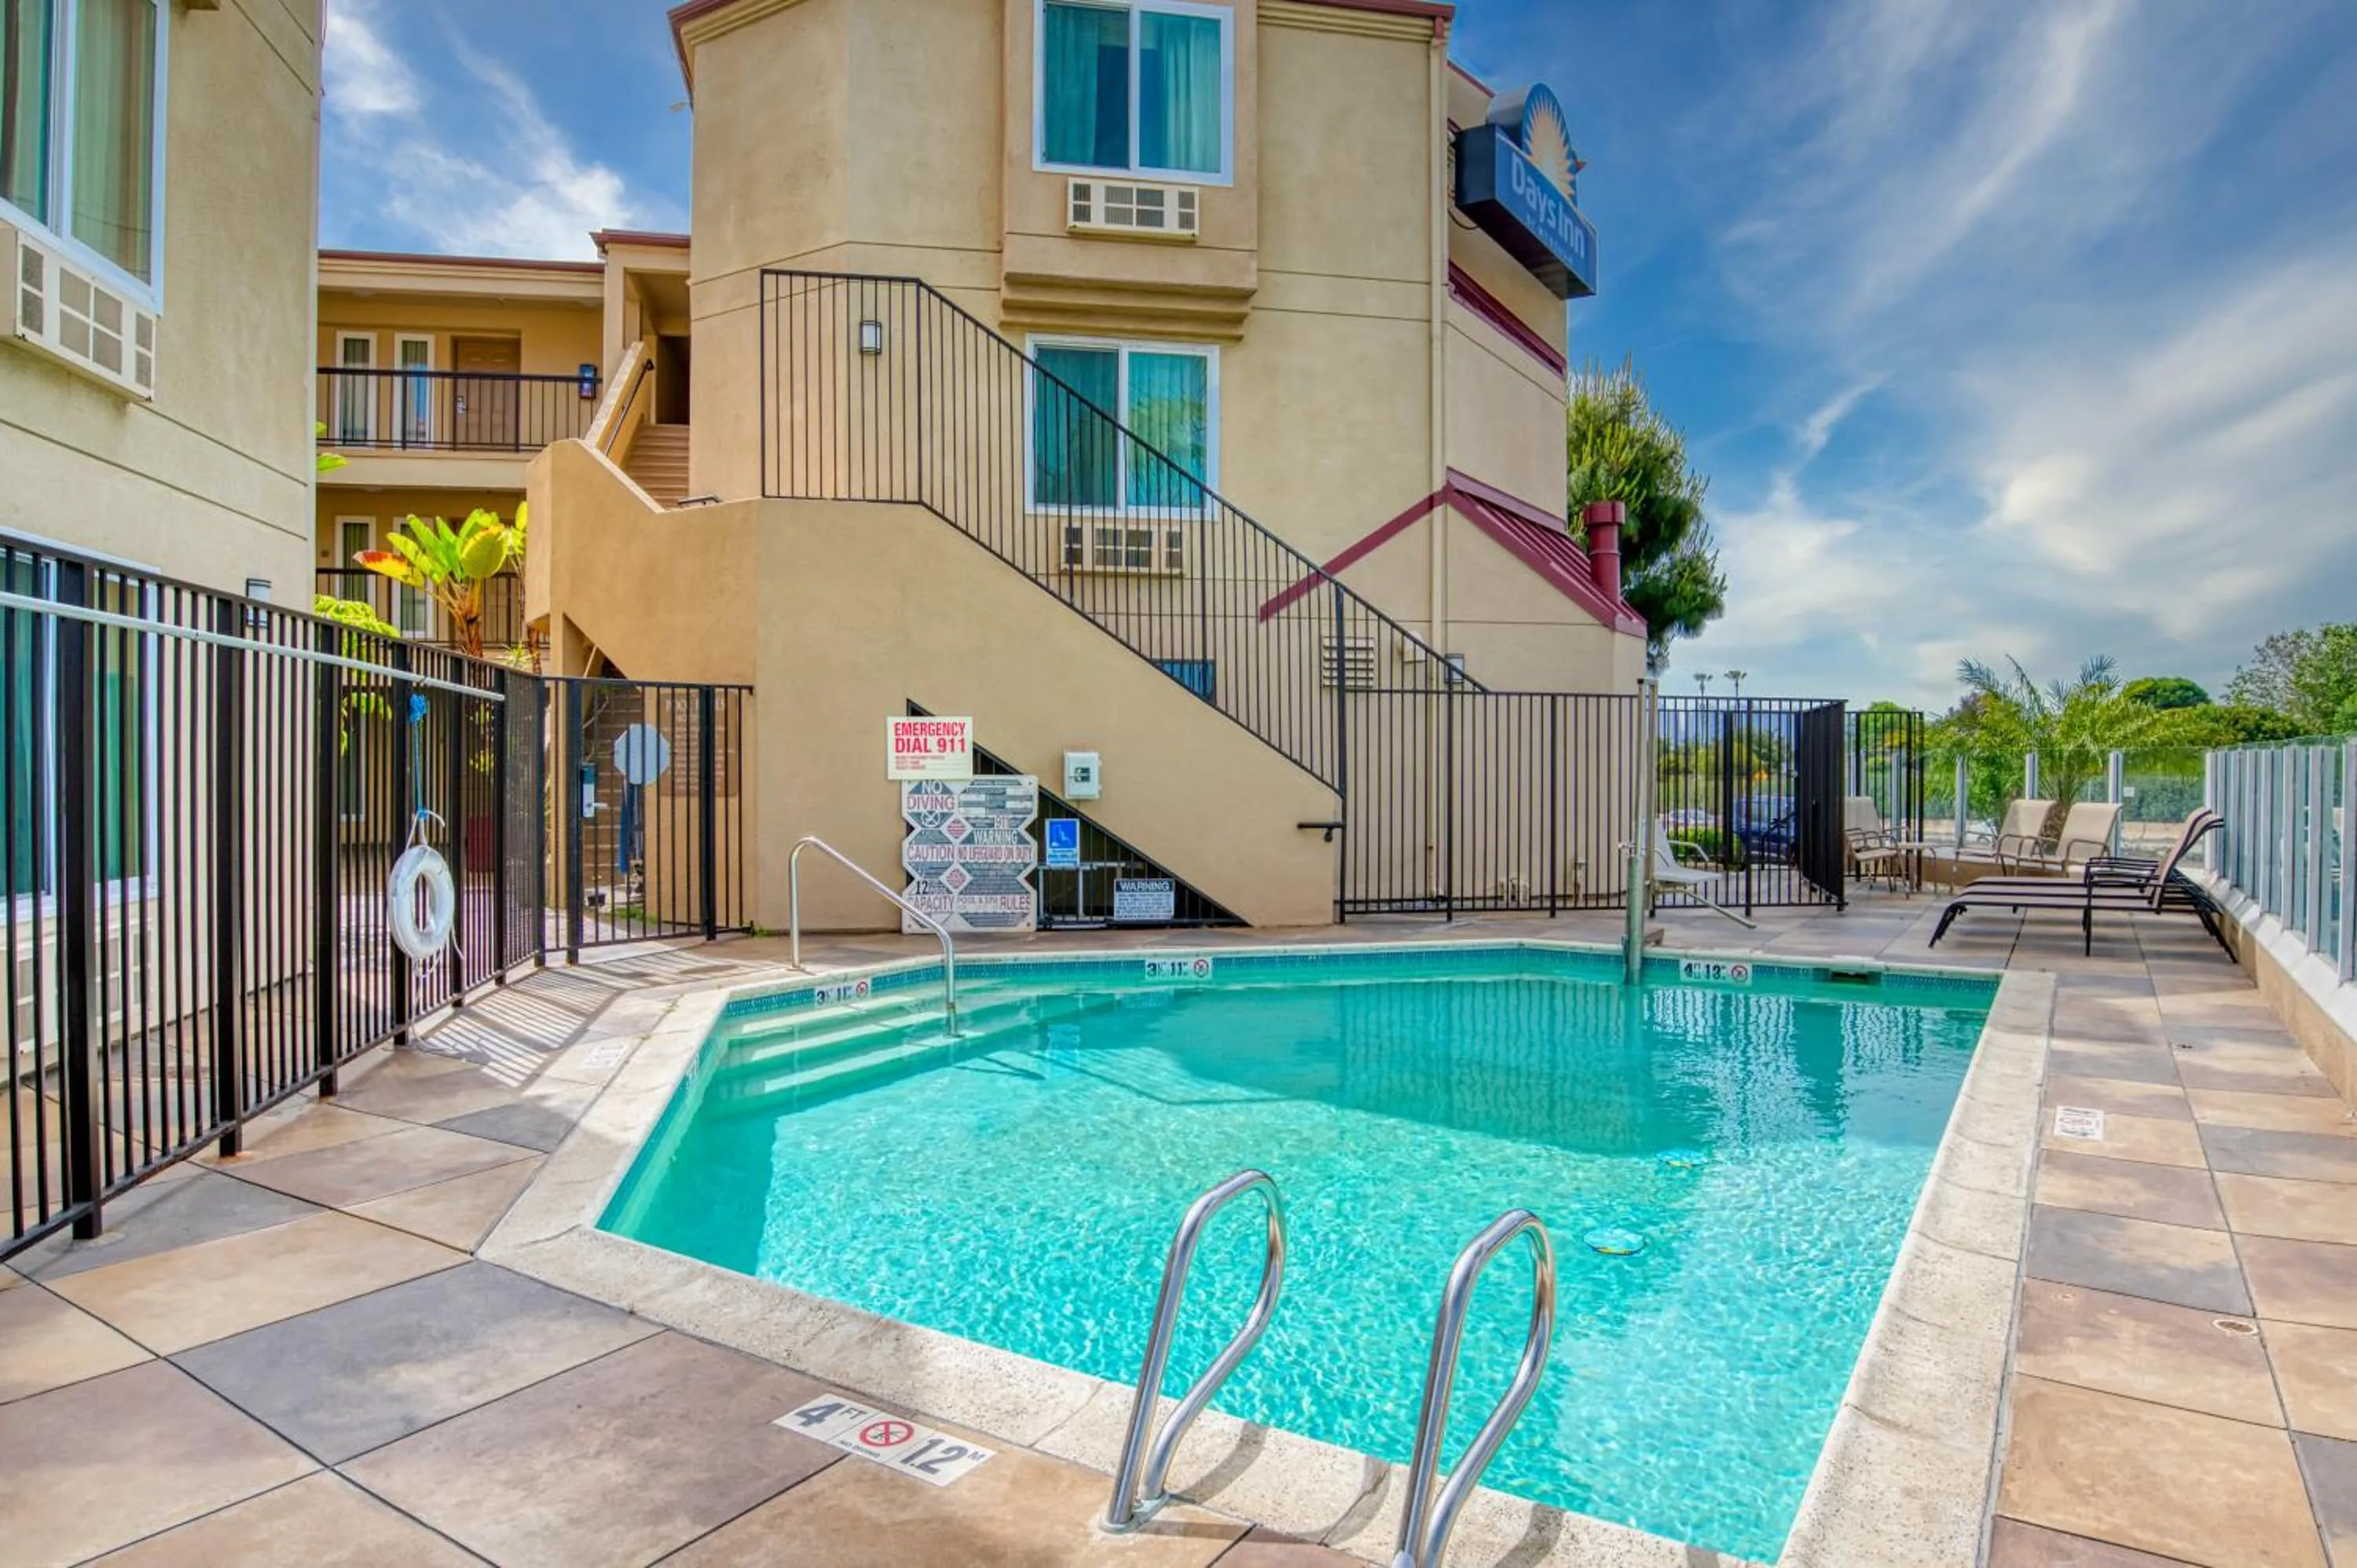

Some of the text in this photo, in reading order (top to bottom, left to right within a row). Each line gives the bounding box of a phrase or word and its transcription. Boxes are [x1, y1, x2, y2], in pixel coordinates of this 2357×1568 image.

[1512, 152, 1556, 229] Days
[1558, 201, 1585, 258] Inn
[894, 722, 966, 736] EMERGENCY
[895, 738, 966, 753] DIAL 911
[922, 780, 943, 794] NO
[907, 795, 955, 810] DIVING
[973, 830, 1018, 845] WARNING
[907, 845, 955, 860] CAUTION
[915, 880, 928, 895] 12
[1119, 881, 1170, 892] WARNING
[1000, 896, 1031, 910] RULES
[795, 1402, 868, 1427] 4 FT
